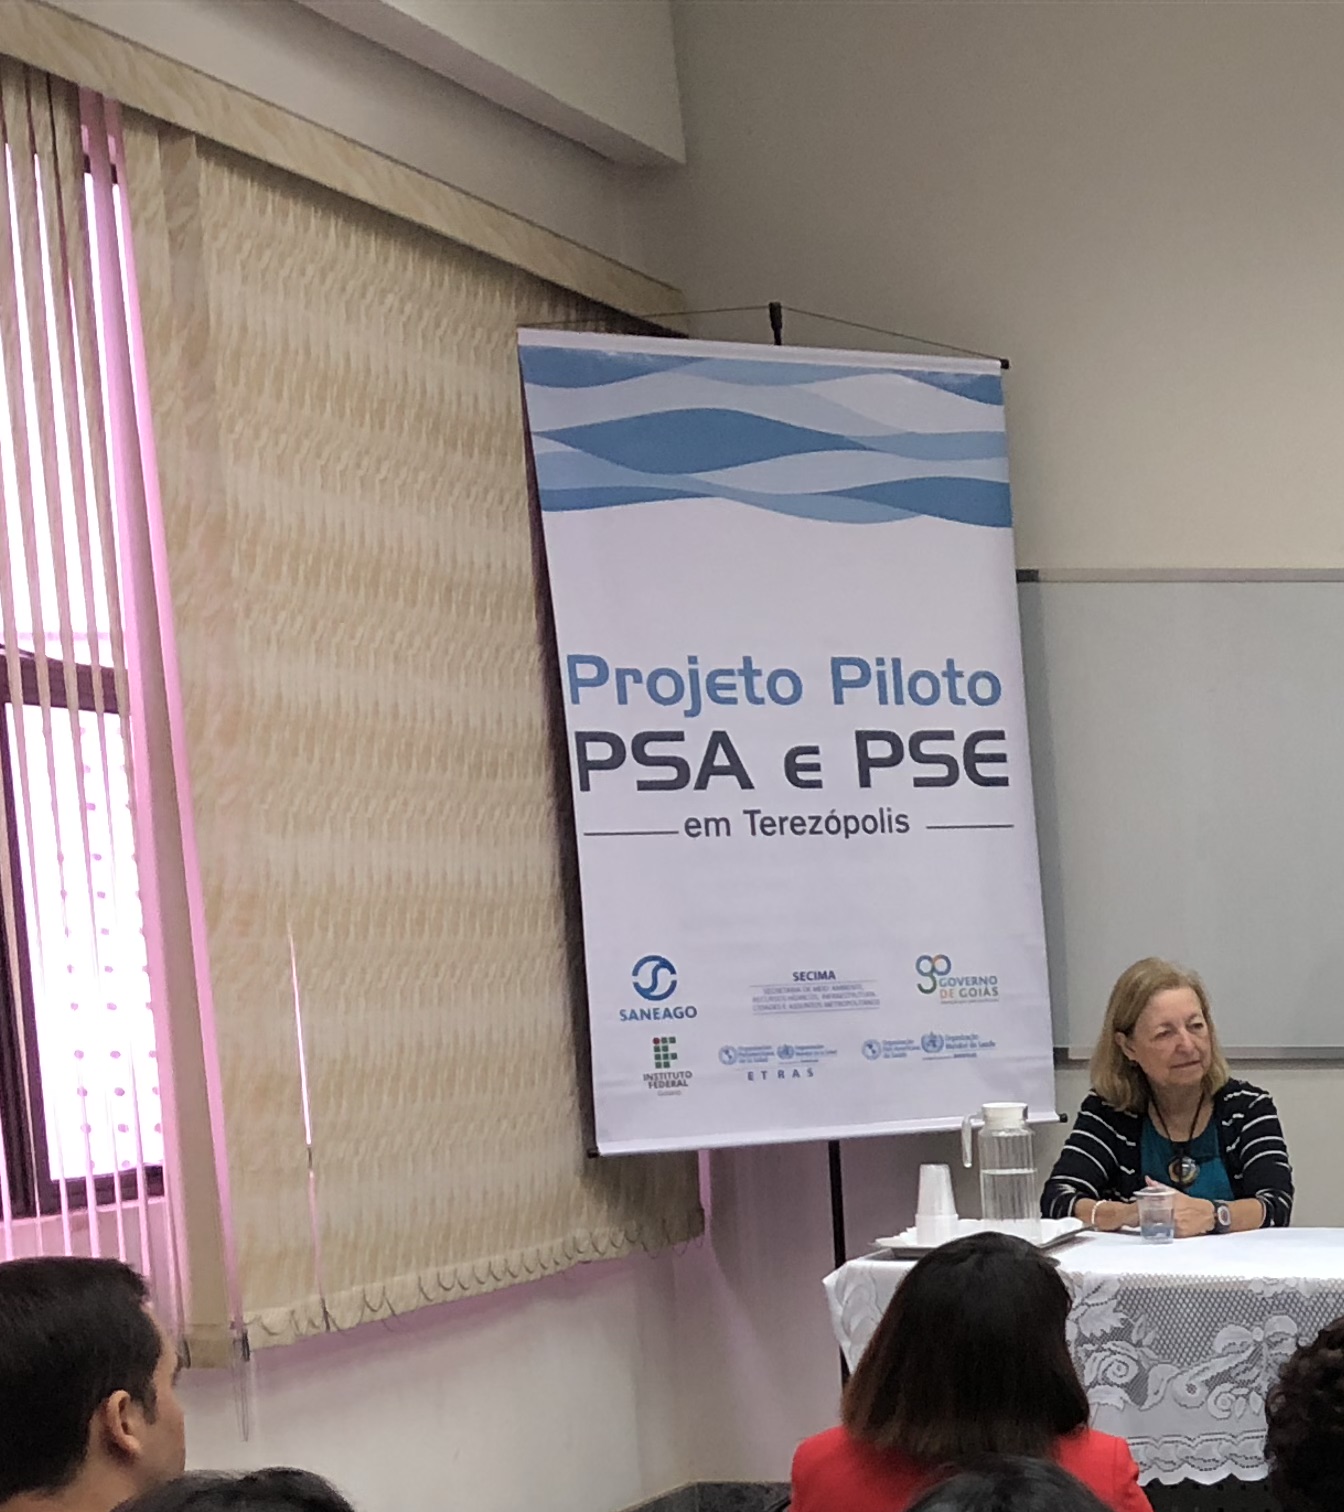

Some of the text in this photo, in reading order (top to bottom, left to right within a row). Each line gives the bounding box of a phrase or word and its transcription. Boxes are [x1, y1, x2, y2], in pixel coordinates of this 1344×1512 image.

[565, 654, 1003, 719] Projeto Piloto
[574, 729, 755, 793] PSA
[855, 729, 1010, 789] PSE
[684, 807, 910, 840] em Terezópolis
[792, 970, 837, 983] SECIMA
[938, 975, 998, 988] GOVERNO
[940, 986, 999, 1000] DE GOIÁS
[619, 1005, 698, 1022] SANEAGO
[642, 1070, 693, 1082] INSTITUTO
[648, 1079, 689, 1090] FEDERAL
